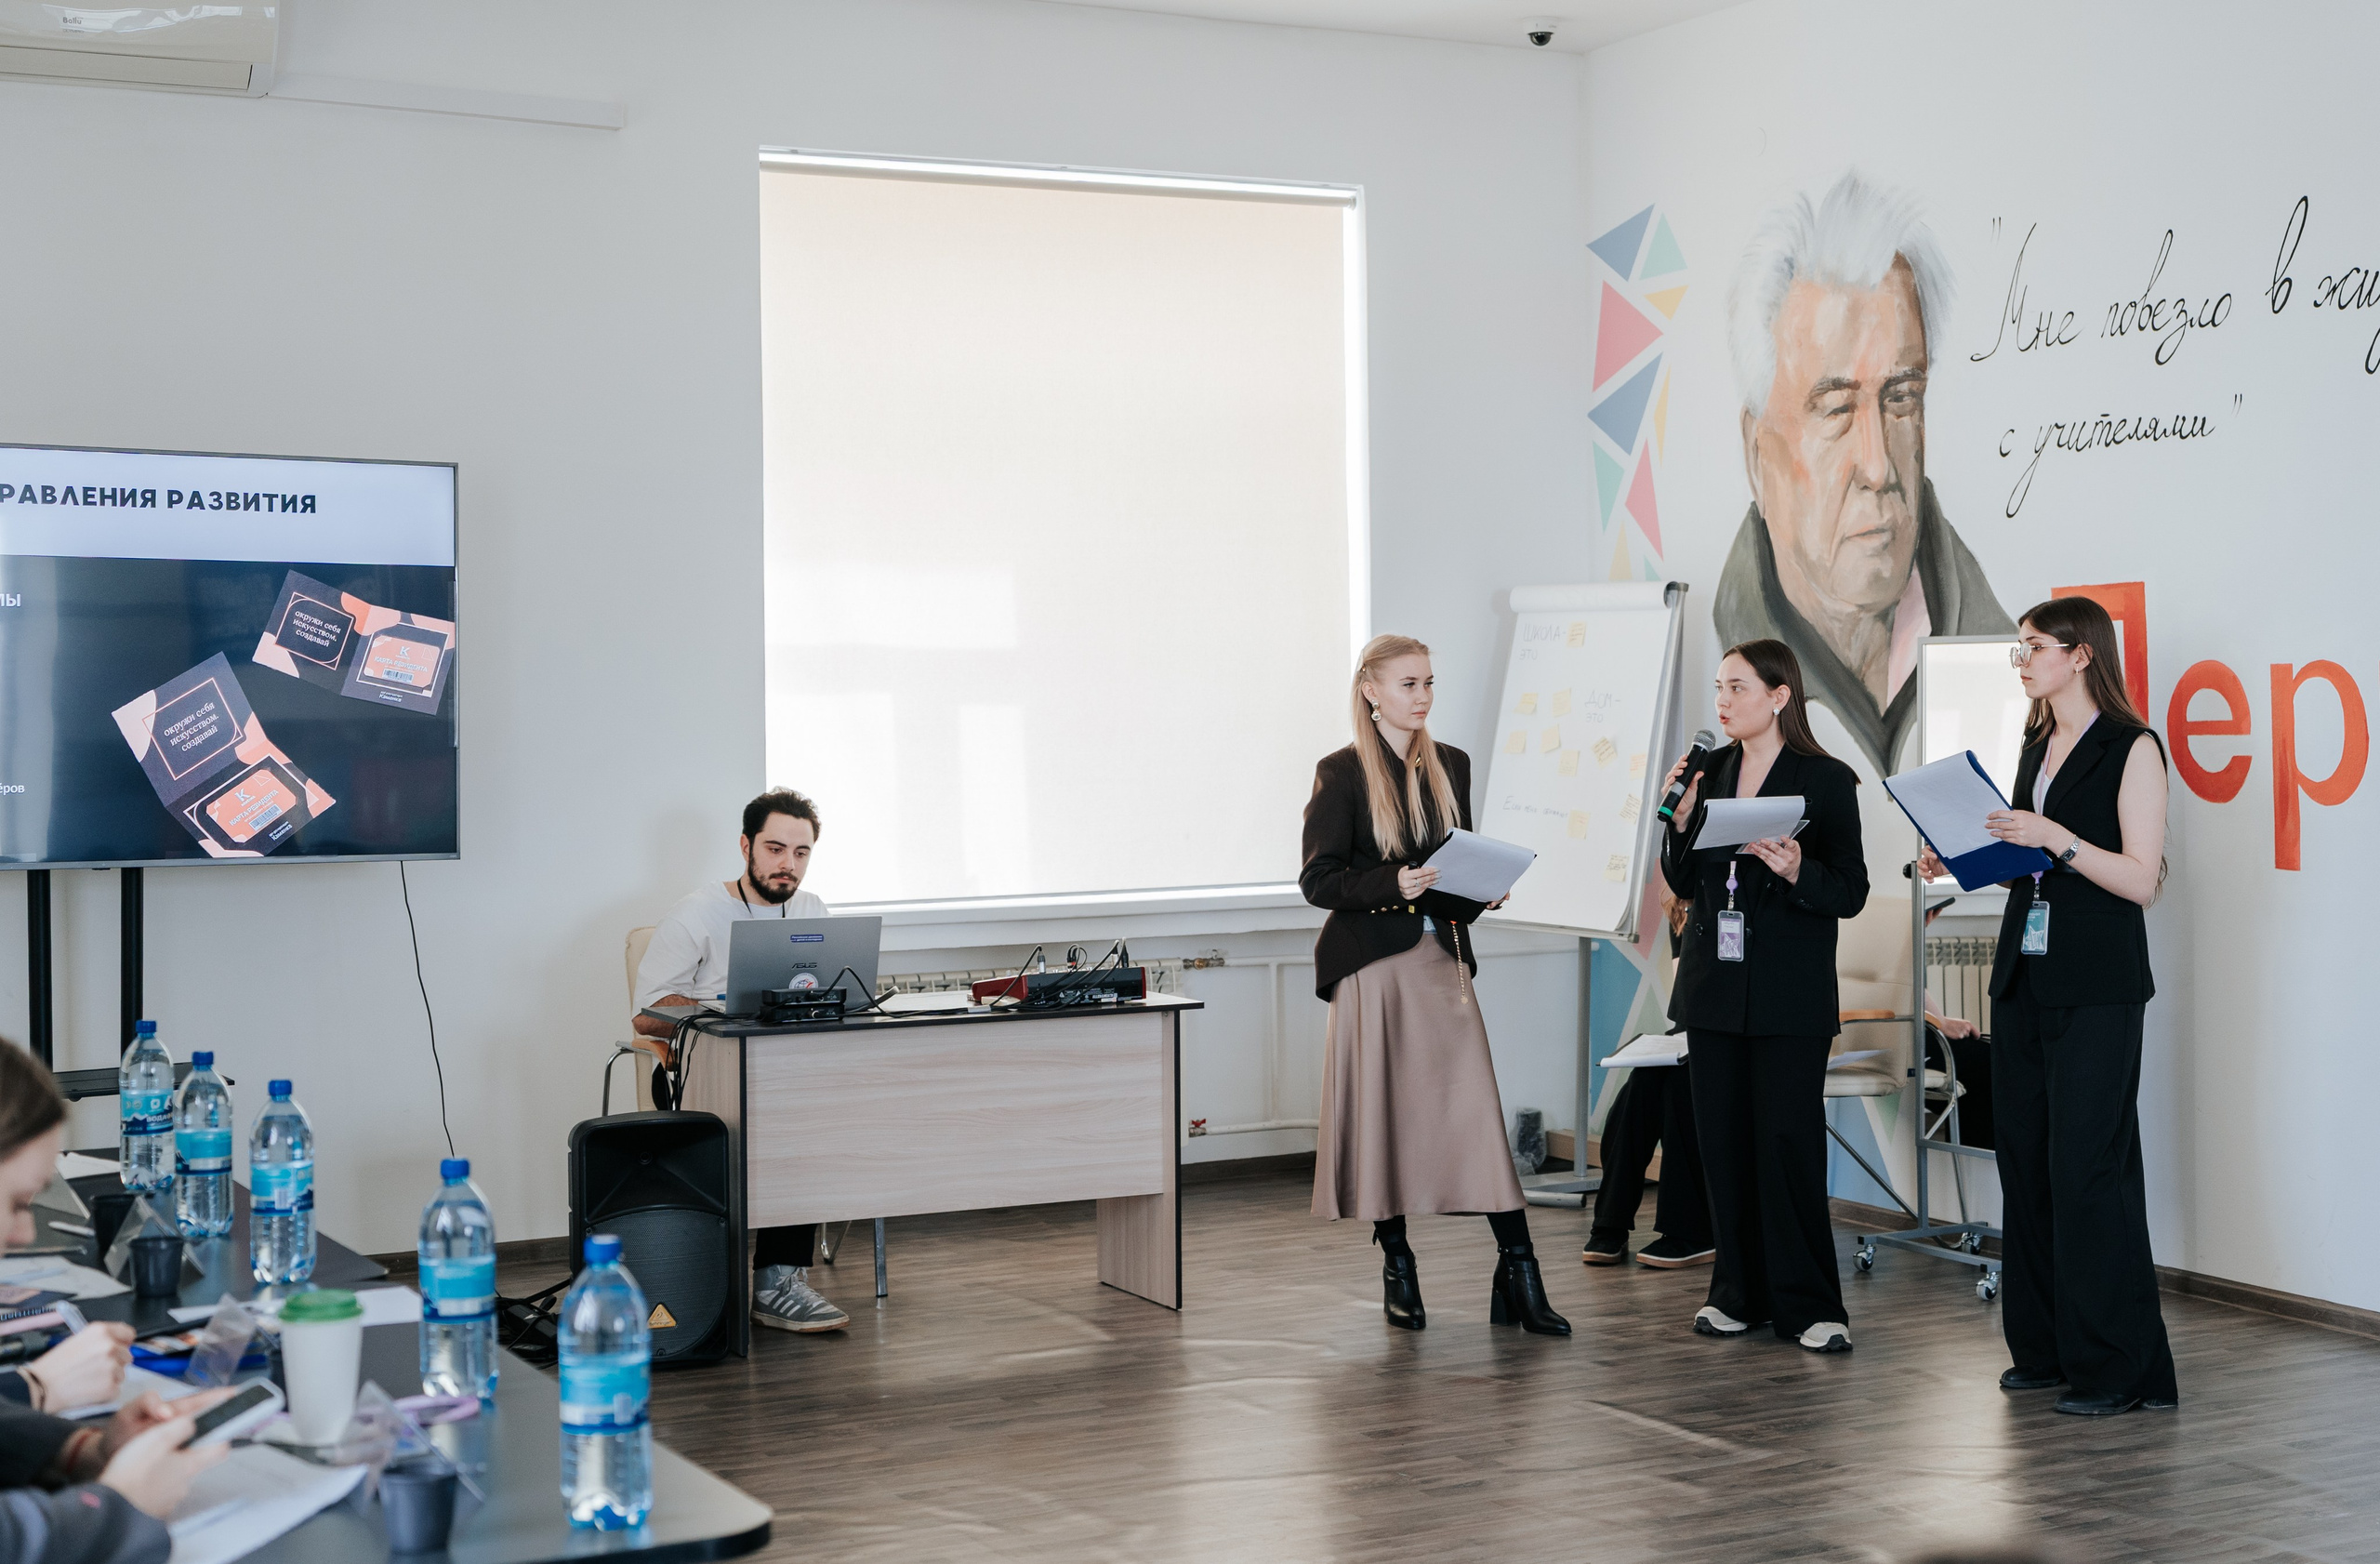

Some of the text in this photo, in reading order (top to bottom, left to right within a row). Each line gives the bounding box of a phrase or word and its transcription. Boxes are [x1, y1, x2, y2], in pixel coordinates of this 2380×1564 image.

[62, 17, 82, 25] Ballu
[2101, 229, 2232, 366] повезло
[2266, 195, 2308, 314] в
[1999, 429, 2015, 457] с
[0, 483, 316, 513] РАВЛЕНИЯ РАЗВИТИЯ
[292, 618, 337, 642] искусством.
[295, 611, 341, 634] окружи себя
[296, 630, 330, 647] создавай
[374, 656, 393, 665] КАРТА
[393, 660, 428, 672] РЕЗИДЕНТА
[164, 702, 216, 736] окружи себя
[169, 713, 219, 747] искусством.
[181, 724, 218, 752] создавай
[229, 810, 249, 826] КАРТА
[247, 789, 279, 814] РЕЗИДЕНТА
